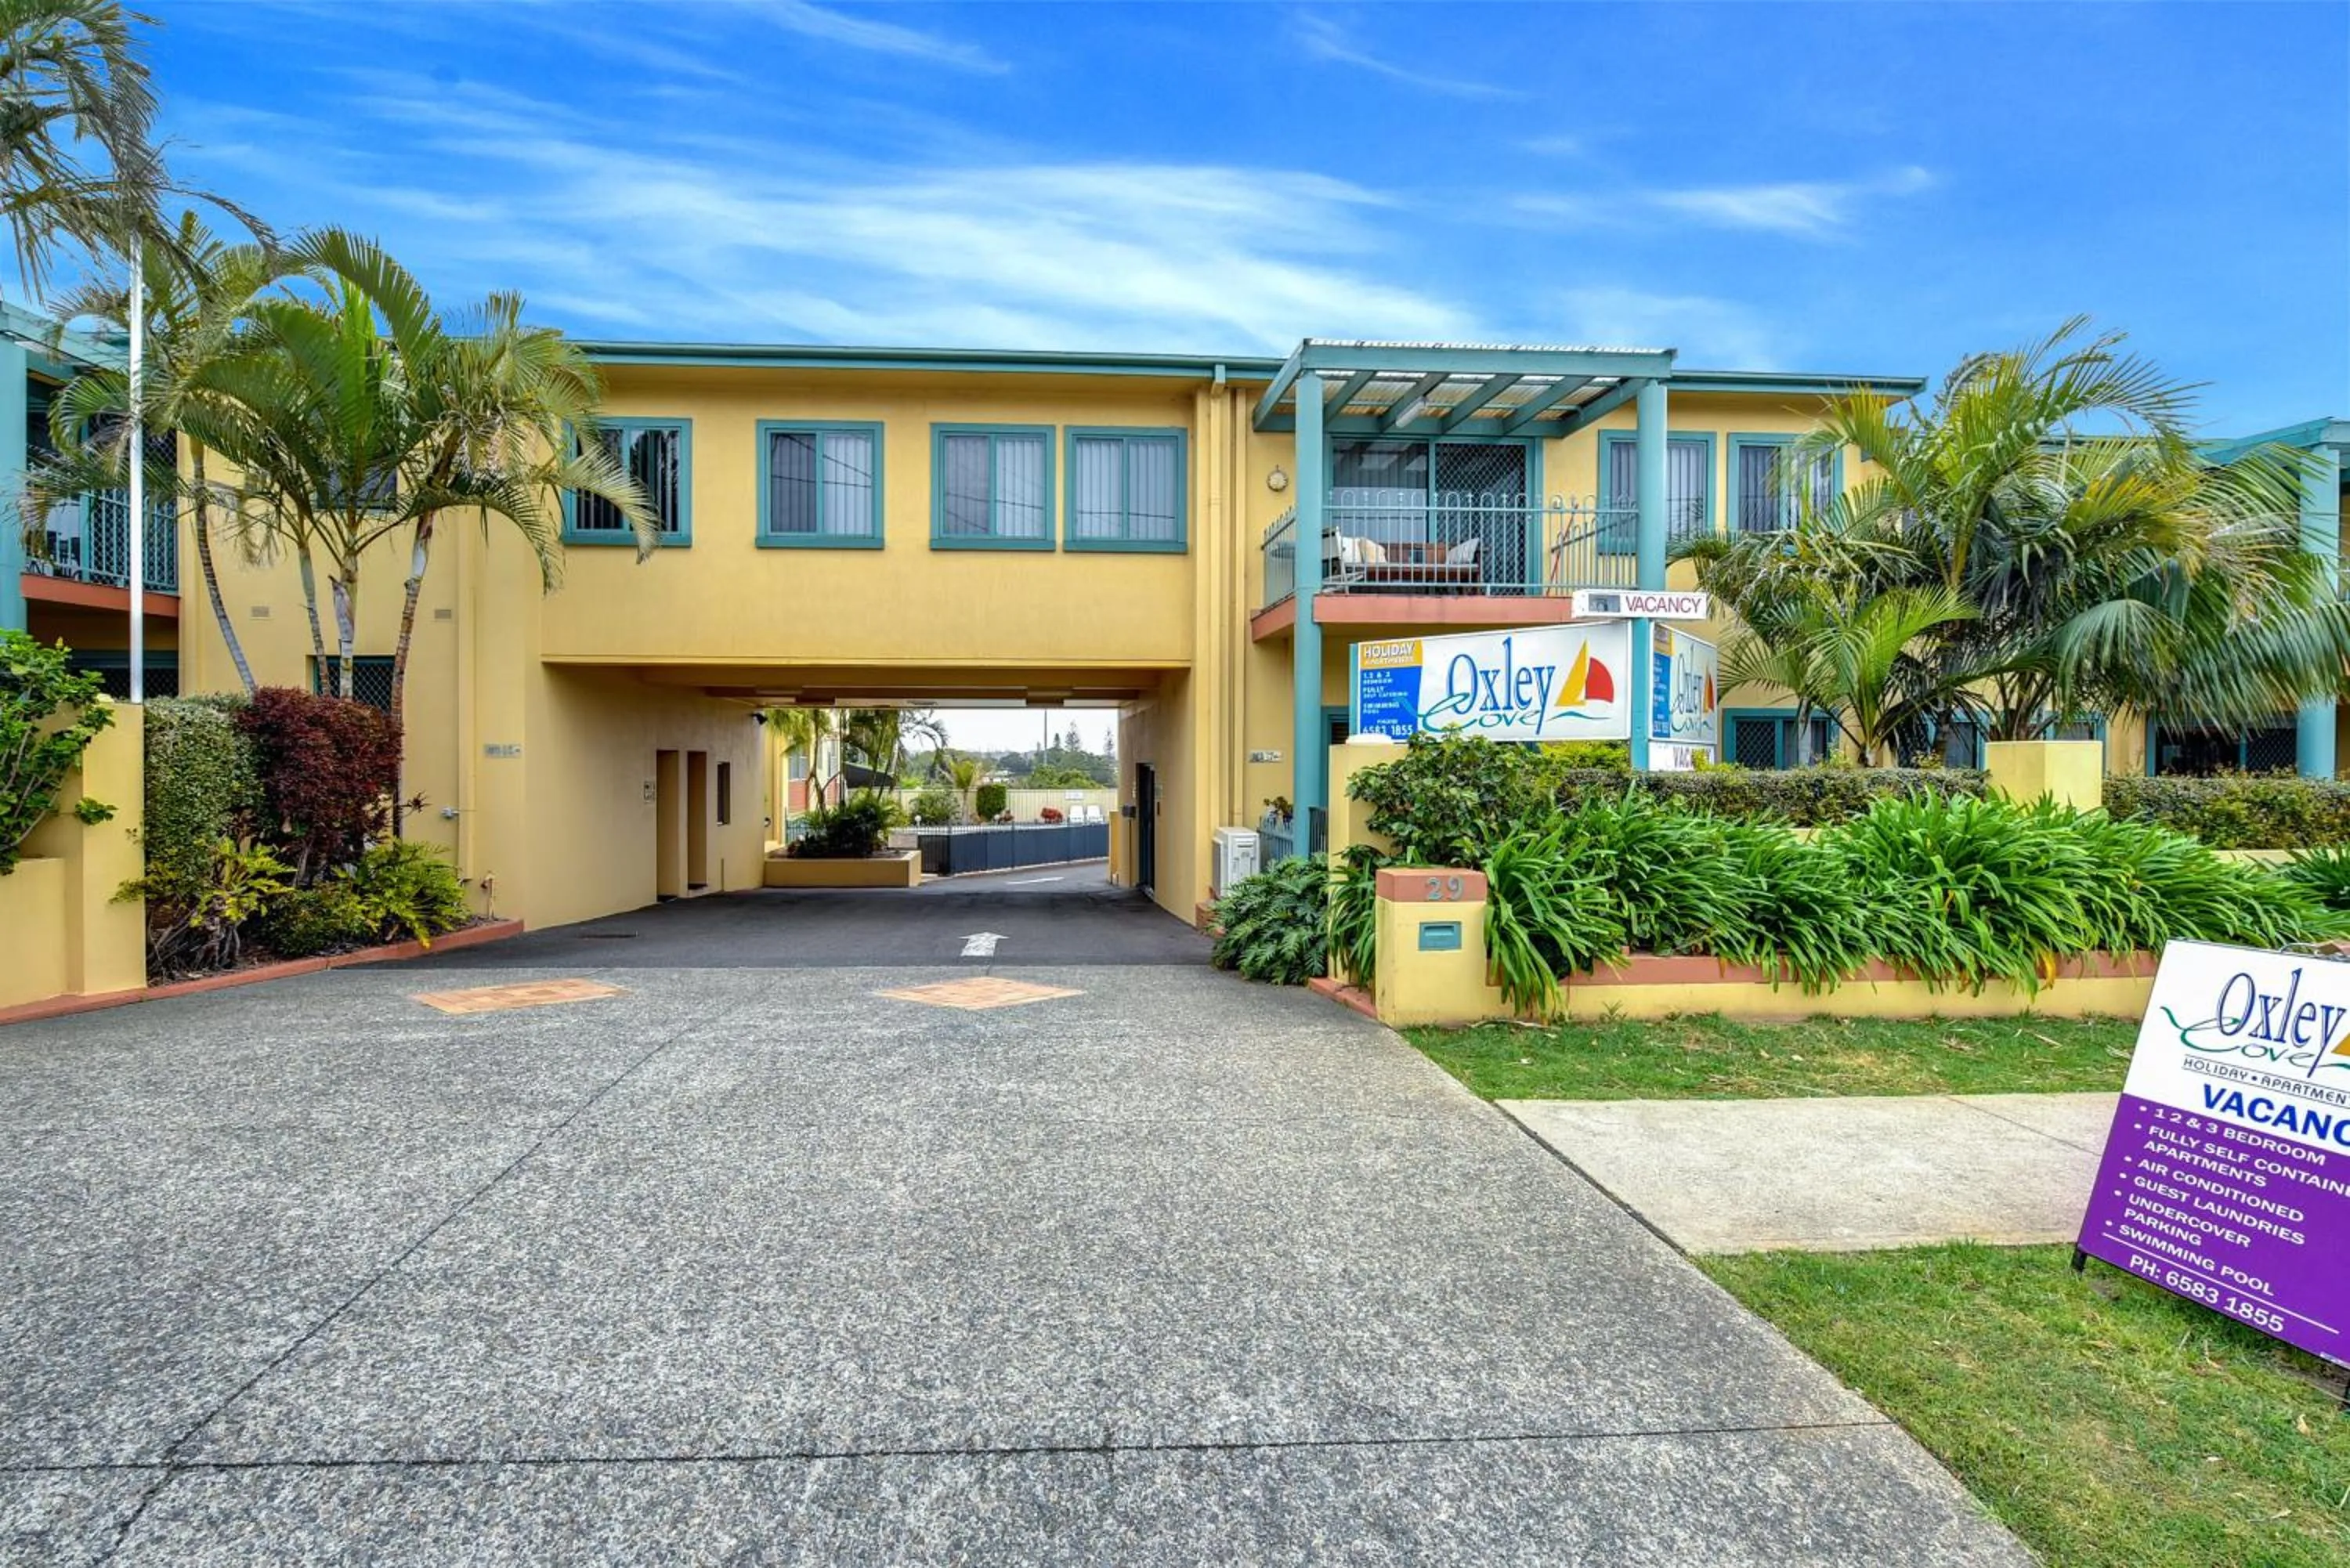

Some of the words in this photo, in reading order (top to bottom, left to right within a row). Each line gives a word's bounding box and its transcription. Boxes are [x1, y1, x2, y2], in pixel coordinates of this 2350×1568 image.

[1625, 595, 1702, 613] VACANCY
[1364, 642, 1414, 659] HOLIDAY
[1447, 636, 1556, 735] Oxley
[1391, 724, 1413, 735] 1855
[1422, 692, 1541, 732] Cove
[1426, 876, 1463, 901] 29
[2180, 1017, 2316, 1068] Cove
[2217, 968, 2347, 1078] Oxley
[2183, 1058, 2248, 1080] HOLIDAY
[2149, 1125, 2200, 1149] FULLY
[2204, 1142, 2251, 1164] SELF
[2154, 1108, 2166, 1119] 1
[2170, 1113, 2182, 1124] 2
[2186, 1118, 2201, 1130] &
[2206, 1122, 2218, 1134] 3
[2223, 1127, 2326, 1166] BEDROOM
[2143, 1140, 2268, 1187] APARTMENTS
[2133, 1176, 2190, 1203] GUEST
[2193, 1197, 2305, 1245] LAUNDRIES
[2138, 1158, 2168, 1176] AIR
[2172, 1170, 2305, 1222] CONDITIONED
[2124, 1207, 2202, 1246] PARKING
[2128, 1193, 2252, 1248] UNDERCOVER
[2119, 1224, 2215, 1271] SWIMMING
[2220, 1265, 2274, 1296] POOL
[2129, 1254, 2161, 1280] PH:
[2166, 1270, 2219, 1304] 6583
[2224, 1297, 2284, 1333] 1855
